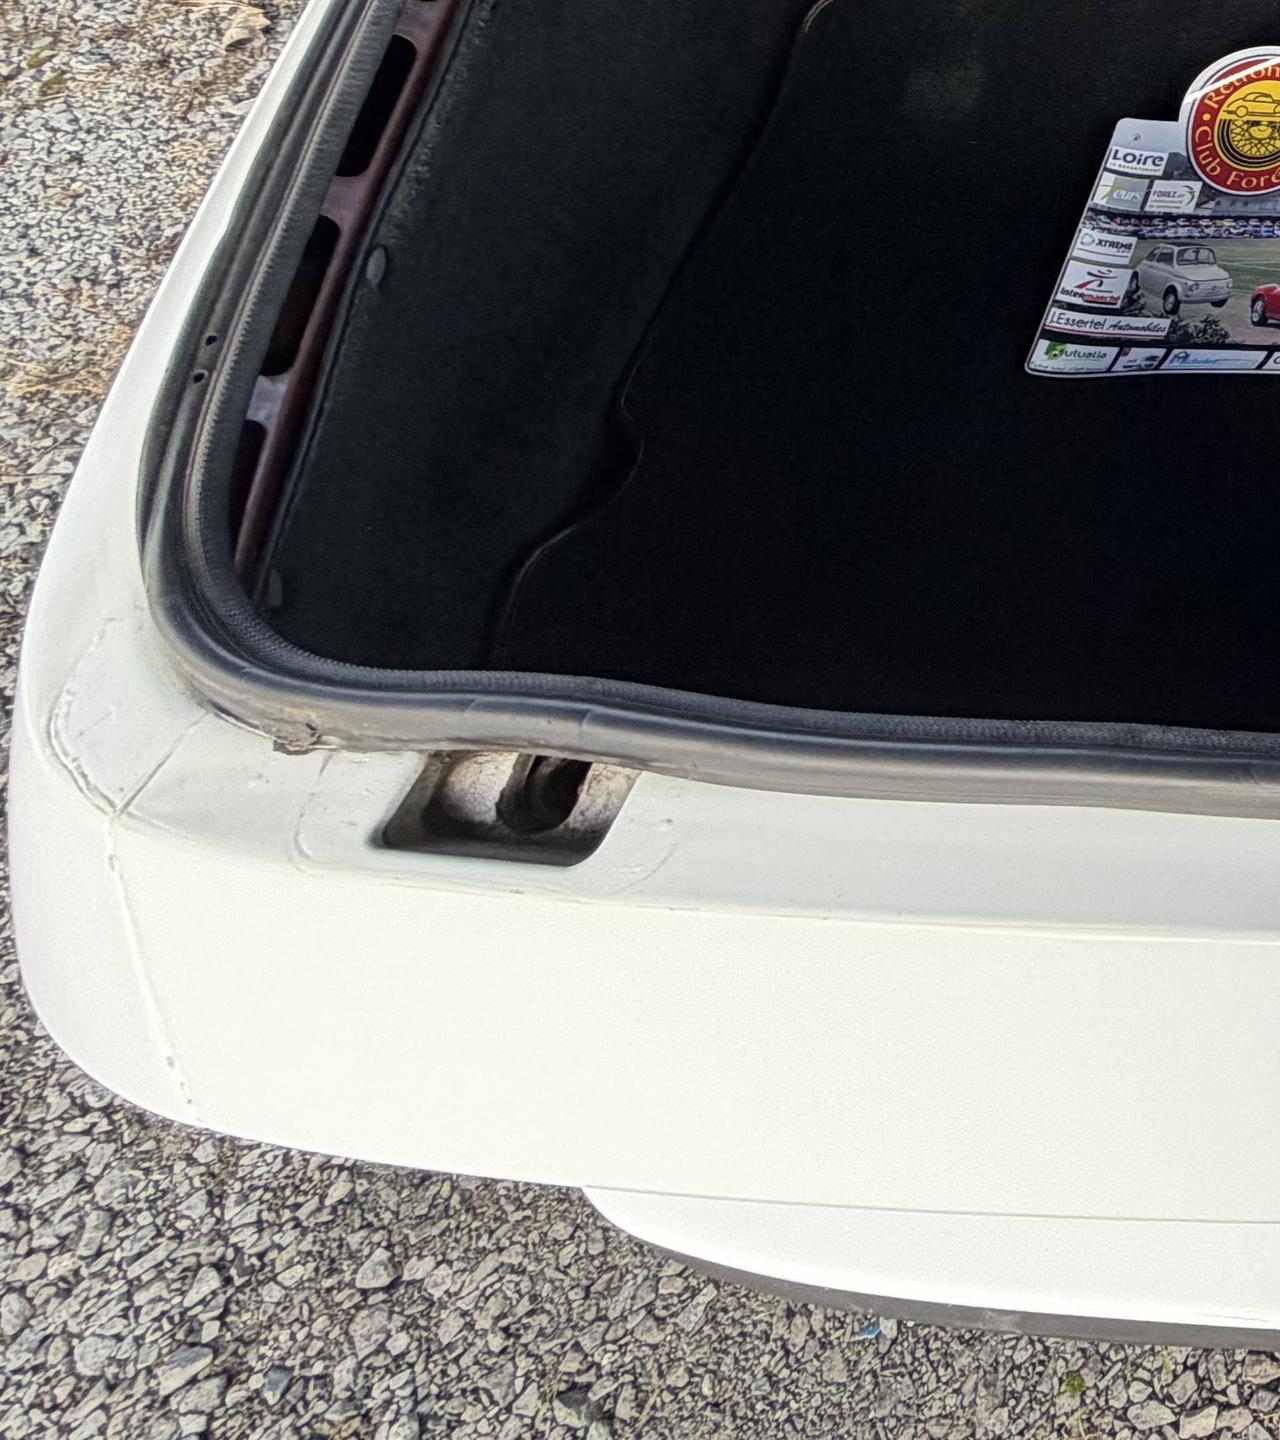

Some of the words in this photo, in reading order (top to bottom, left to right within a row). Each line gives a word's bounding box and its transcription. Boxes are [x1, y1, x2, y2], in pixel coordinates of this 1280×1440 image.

[1112, 148, 1165, 167] Loire
[1195, 125, 1222, 176] Club
[1096, 238, 1133, 250] XTREME
